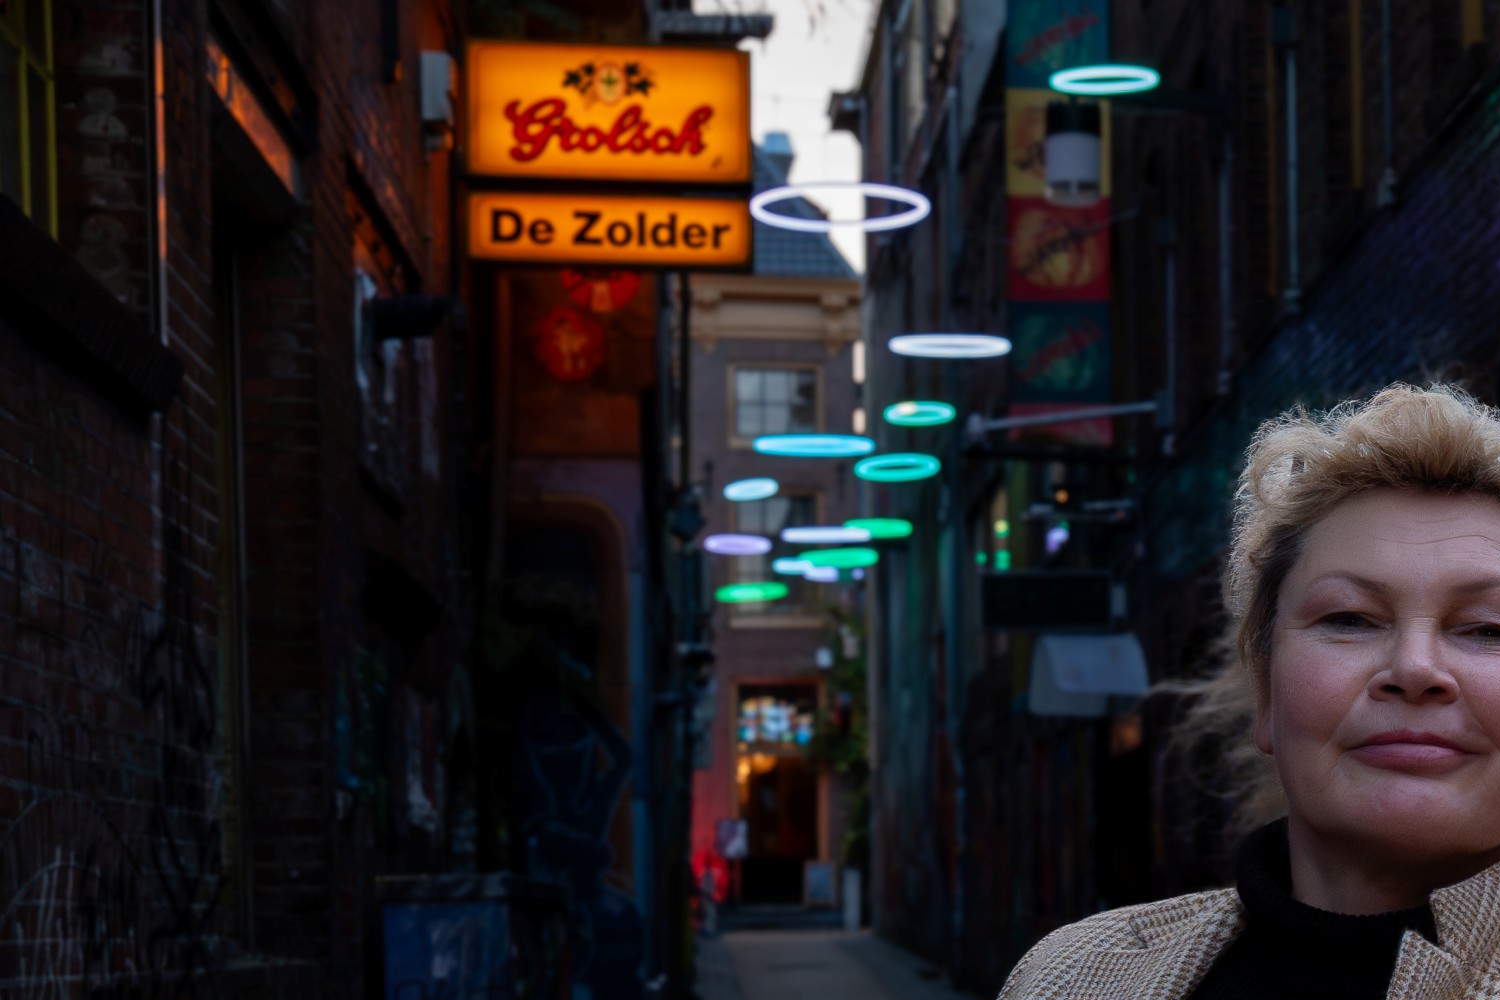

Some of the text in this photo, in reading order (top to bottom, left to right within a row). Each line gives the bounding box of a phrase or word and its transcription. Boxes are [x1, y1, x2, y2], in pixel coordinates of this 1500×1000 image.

[504, 98, 714, 162] Grolsch
[491, 208, 731, 249] De Zolder
